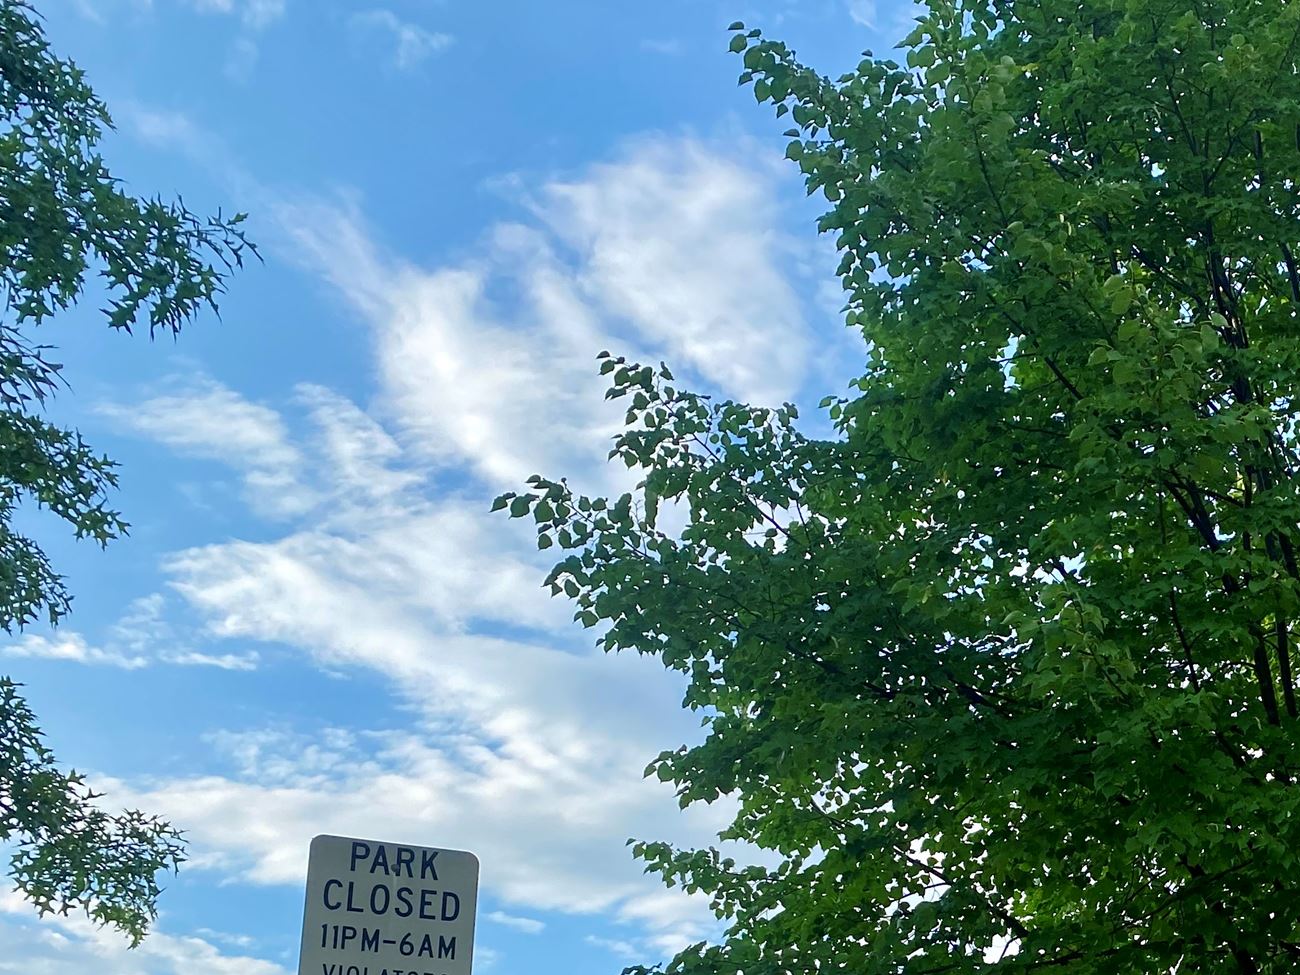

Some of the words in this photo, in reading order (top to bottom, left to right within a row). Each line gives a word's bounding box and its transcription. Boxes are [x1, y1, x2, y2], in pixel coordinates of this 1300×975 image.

[350, 842, 439, 880] PARK
[324, 879, 460, 921] CLOSED
[321, 924, 456, 960] 11PM-6AM
